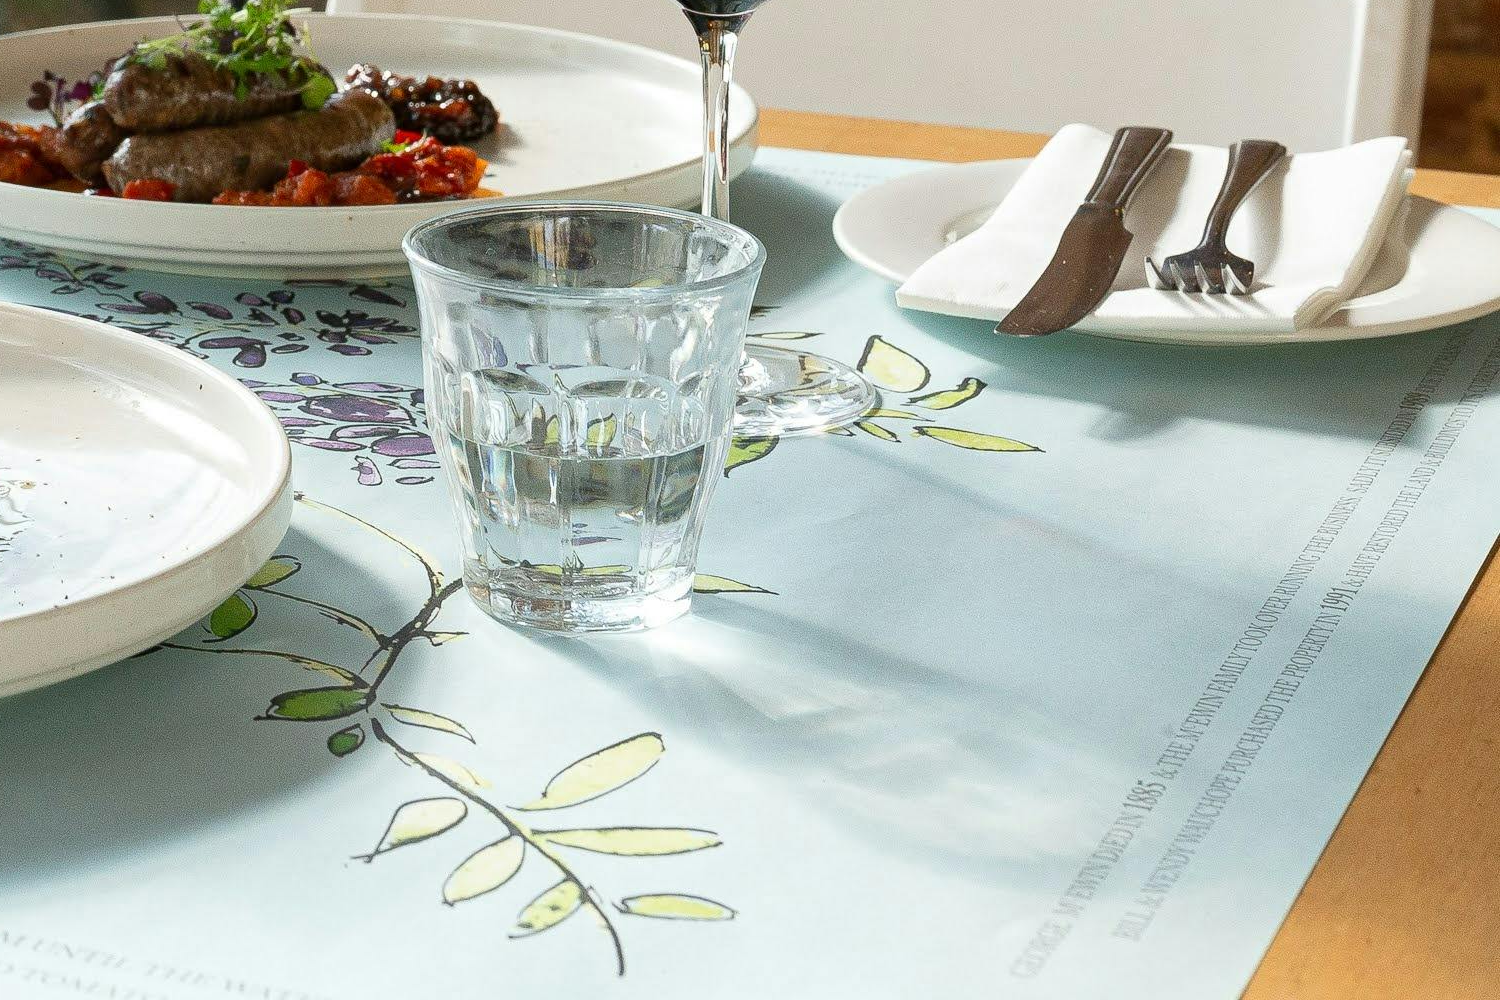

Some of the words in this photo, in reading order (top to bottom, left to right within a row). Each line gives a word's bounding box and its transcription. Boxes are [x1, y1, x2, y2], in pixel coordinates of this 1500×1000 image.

[1424, 418, 1467, 460] BUILDINGS
[1364, 456, 1387, 467] IT
[1346, 465, 1381, 493] SADLY
[1404, 466, 1436, 490] LAND
[1392, 490, 1422, 508] THE
[1302, 536, 1335, 554] THE
[1363, 509, 1409, 554] RESTORED
[1273, 553, 1321, 597] RUNNING
[1345, 553, 1381, 579] HAVE
[1340, 579, 1365, 588] &
[1255, 596, 1292, 623] OVER
[1320, 587, 1359, 612] 1991
[1315, 611, 1342, 626] IN
[1233, 622, 1274, 652] TOOK
[1281, 624, 1334, 679] PROPERTY
[1207, 652, 1251, 693] FAMILY
[1264, 677, 1301, 704] THE
[1221, 704, 1284, 774] PURCHASED
[1157, 742, 1194, 767] THE
[1123, 780, 1167, 811] 1885
